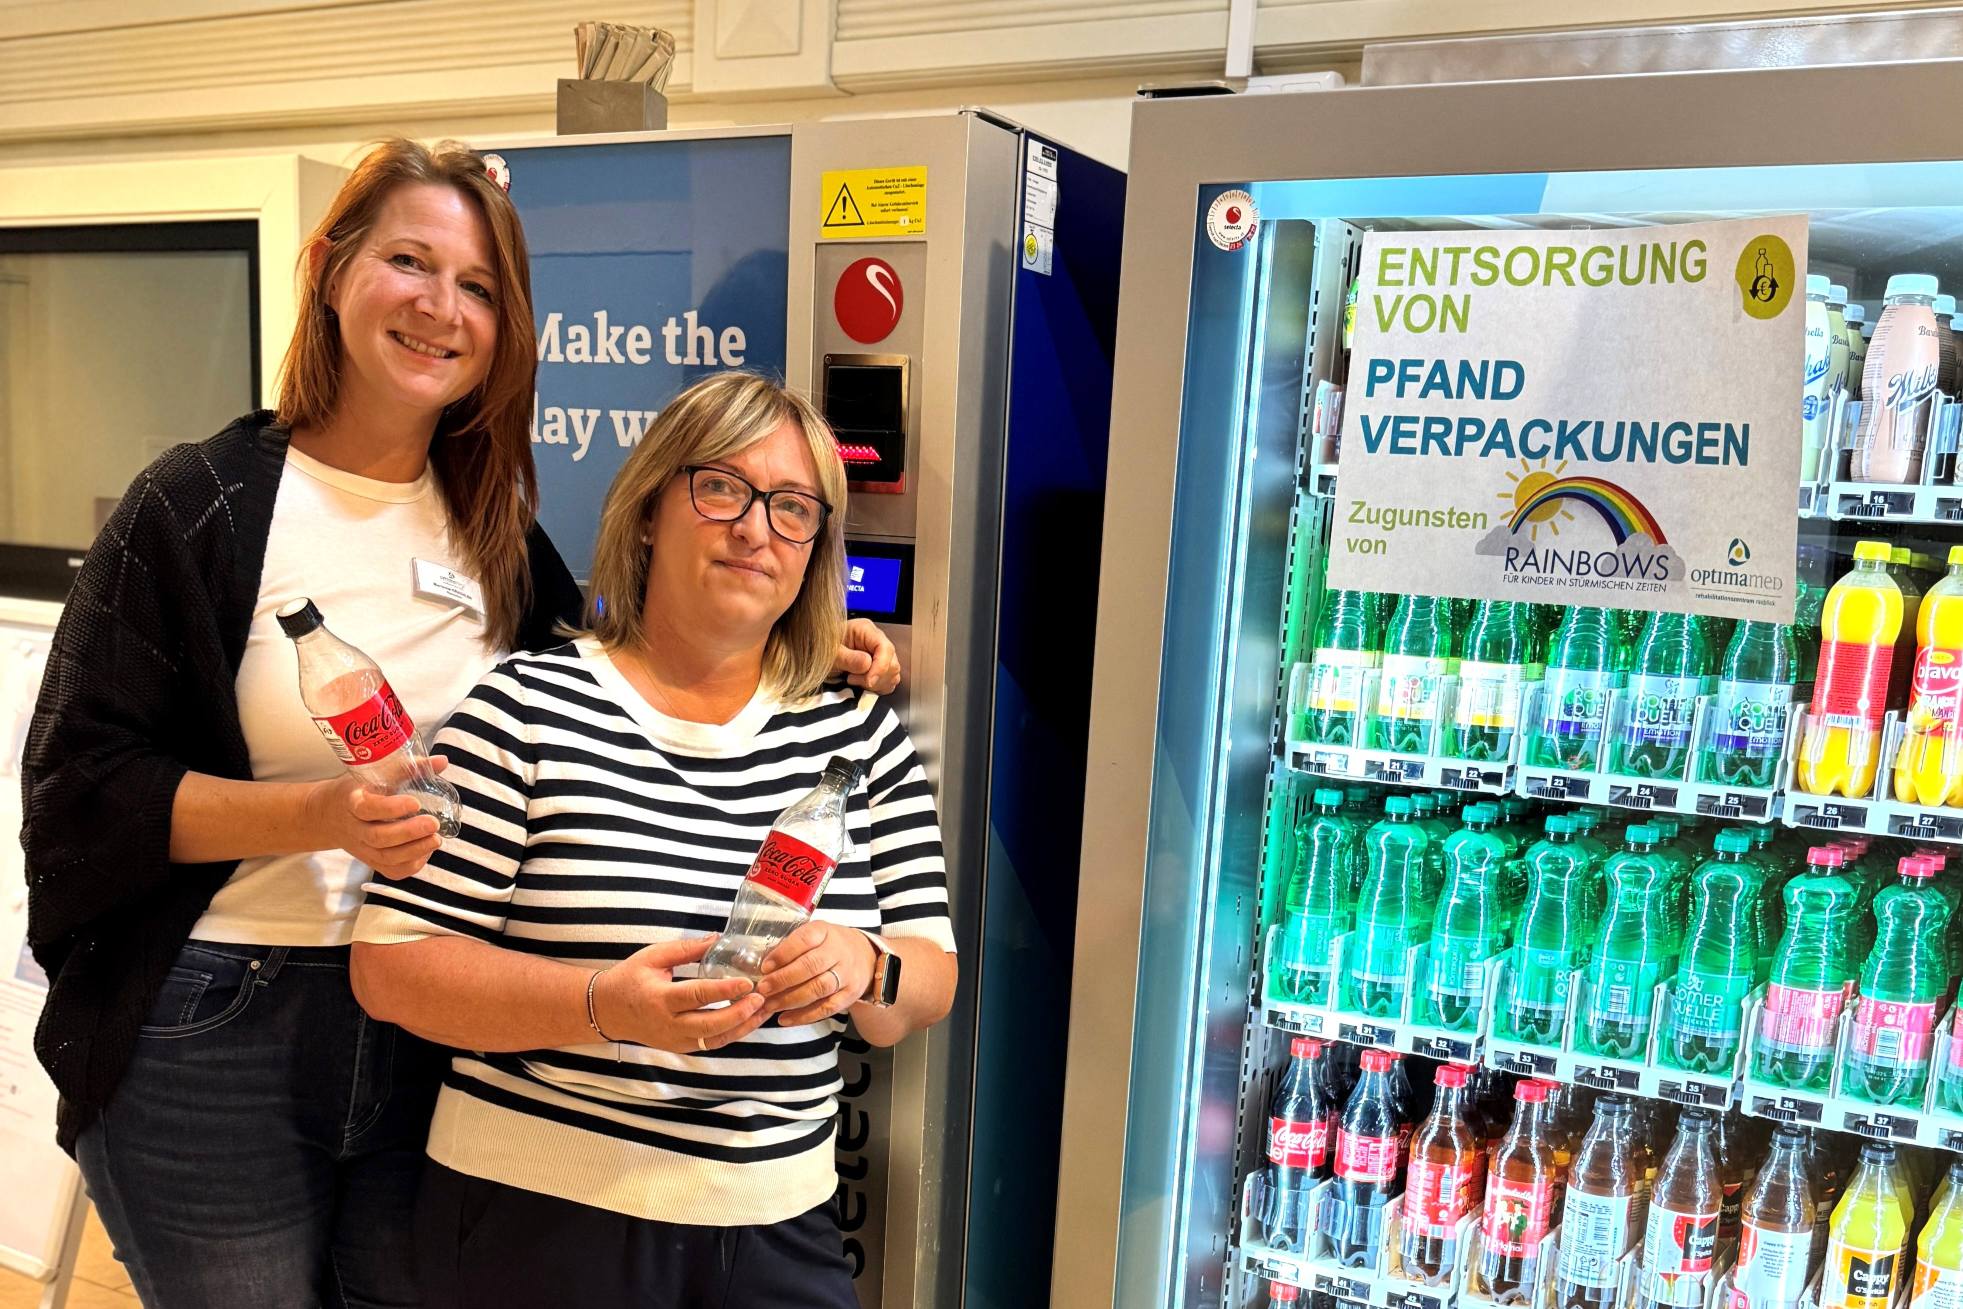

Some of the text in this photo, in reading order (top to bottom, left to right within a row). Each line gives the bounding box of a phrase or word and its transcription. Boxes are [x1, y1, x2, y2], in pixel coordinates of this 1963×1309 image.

[1376, 239, 1708, 288] ENTSORGUNG
[1372, 294, 1472, 334] VON
[661, 310, 747, 367] the
[1365, 358, 1526, 400] PFAND
[1359, 414, 1751, 467] VERPACKUNGEN
[1873, 495, 1884, 504] 16
[1348, 500, 1488, 530] Zugunsten
[1346, 537, 1387, 555] von
[1504, 547, 1670, 581] RAINBOWS
[1503, 572, 1667, 593] FÜR KINDER IN STÜRMISCHEN ZEITEN
[1468, 770, 1478, 778] 22
[1554, 778, 1564, 787] 23
[1640, 787, 1651, 796] 24
[1728, 796, 1739, 805] 25
[1826, 806, 1838, 815] 26
[1922, 816, 1934, 825] 27
[1364, 1026, 1372, 1034] 31
[1438, 1040, 1447, 1048] 32
[1522, 1054, 1532, 1062] 33
[1604, 1069, 1614, 1077] 34
[1689, 1084, 1699, 1092] 35
[1877, 1116, 1888, 1125] 37
[1853, 1270, 1890, 1285] Cappy
